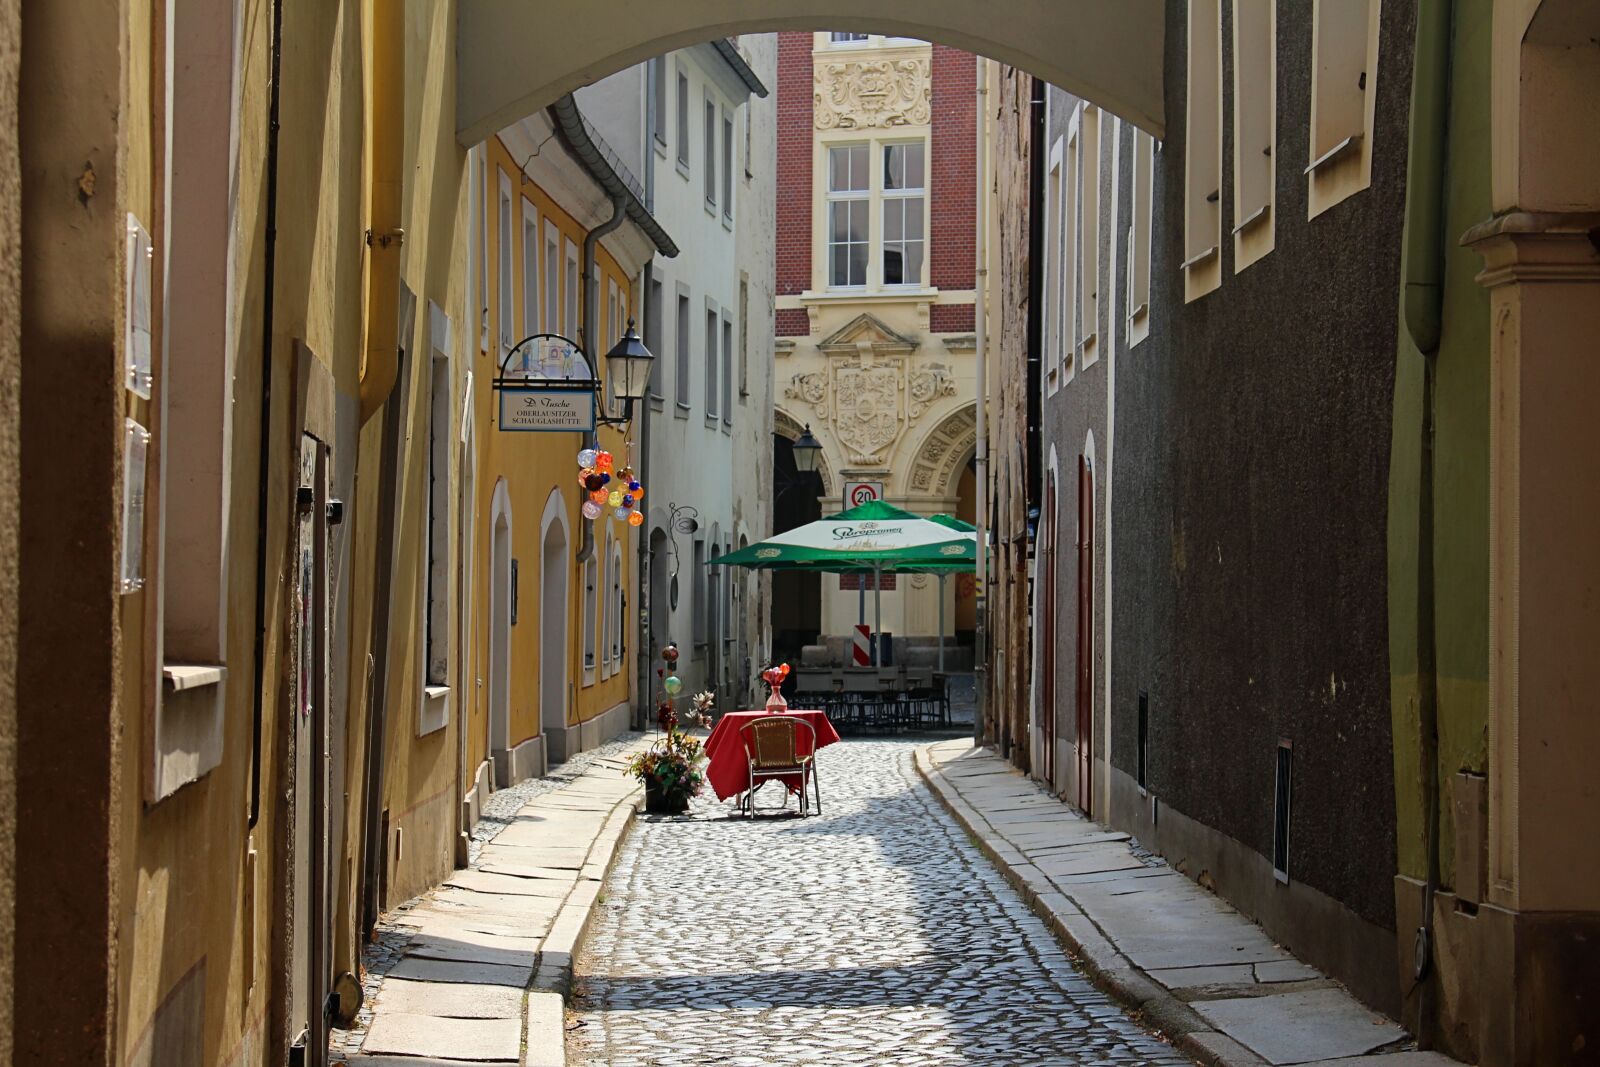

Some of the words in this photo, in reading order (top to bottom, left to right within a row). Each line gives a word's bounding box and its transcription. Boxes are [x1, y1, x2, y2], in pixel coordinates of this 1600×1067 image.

[511, 417, 581, 425] SCHAUGLASHÜTTE
[857, 491, 872, 503] 20
[832, 526, 904, 541] Staropramen
